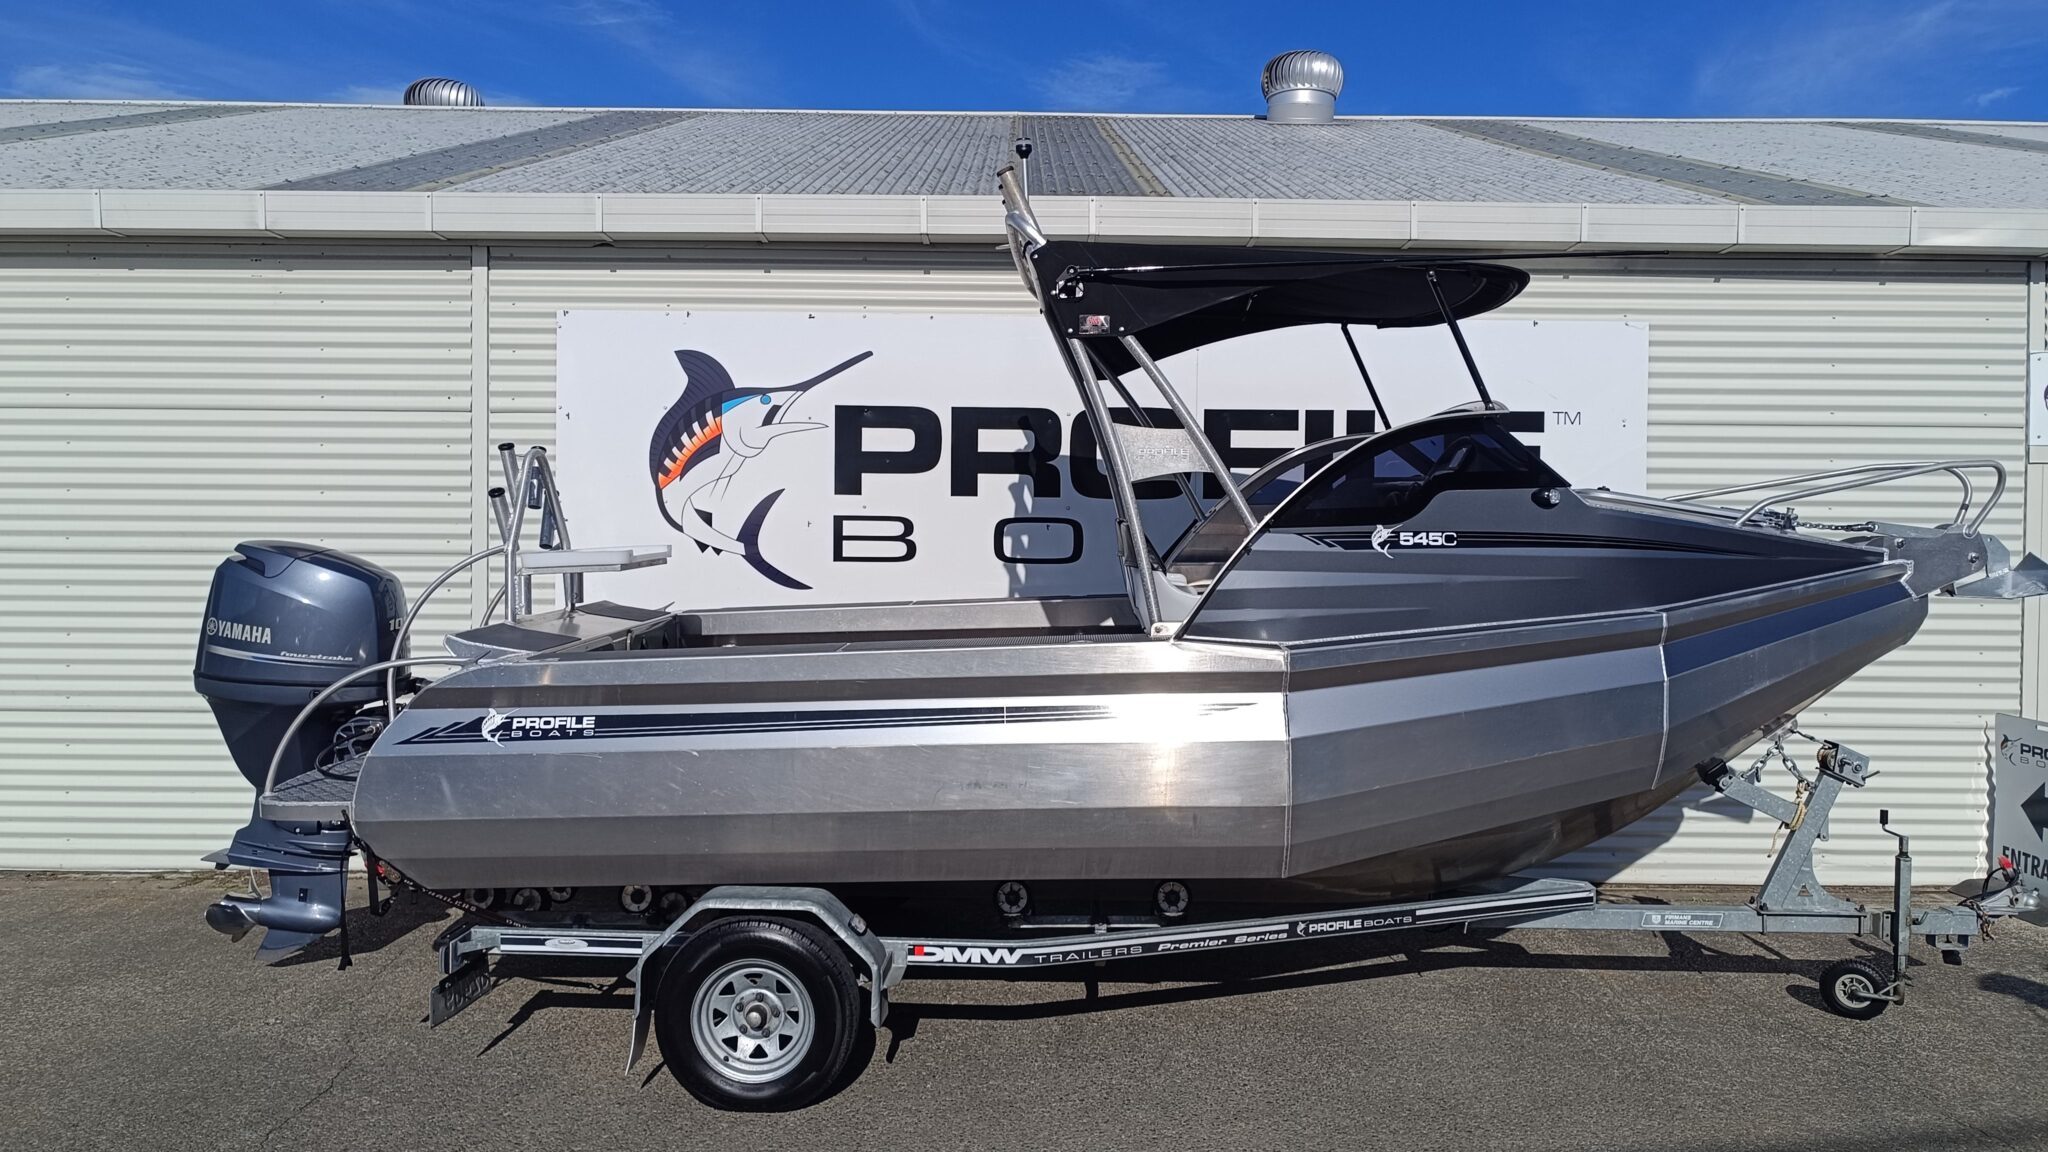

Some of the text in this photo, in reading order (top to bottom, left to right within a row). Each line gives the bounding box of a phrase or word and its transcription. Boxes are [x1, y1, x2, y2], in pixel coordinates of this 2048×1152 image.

[1399, 532, 1457, 546] 545C
[217, 619, 272, 645] YAMAHA
[512, 716, 596, 730] PROFILE
[511, 729, 595, 738] BOATS
[1308, 915, 1413, 934] PROFILE BOATS
[907, 930, 1289, 965] DMW TRAILERS Premier Series
